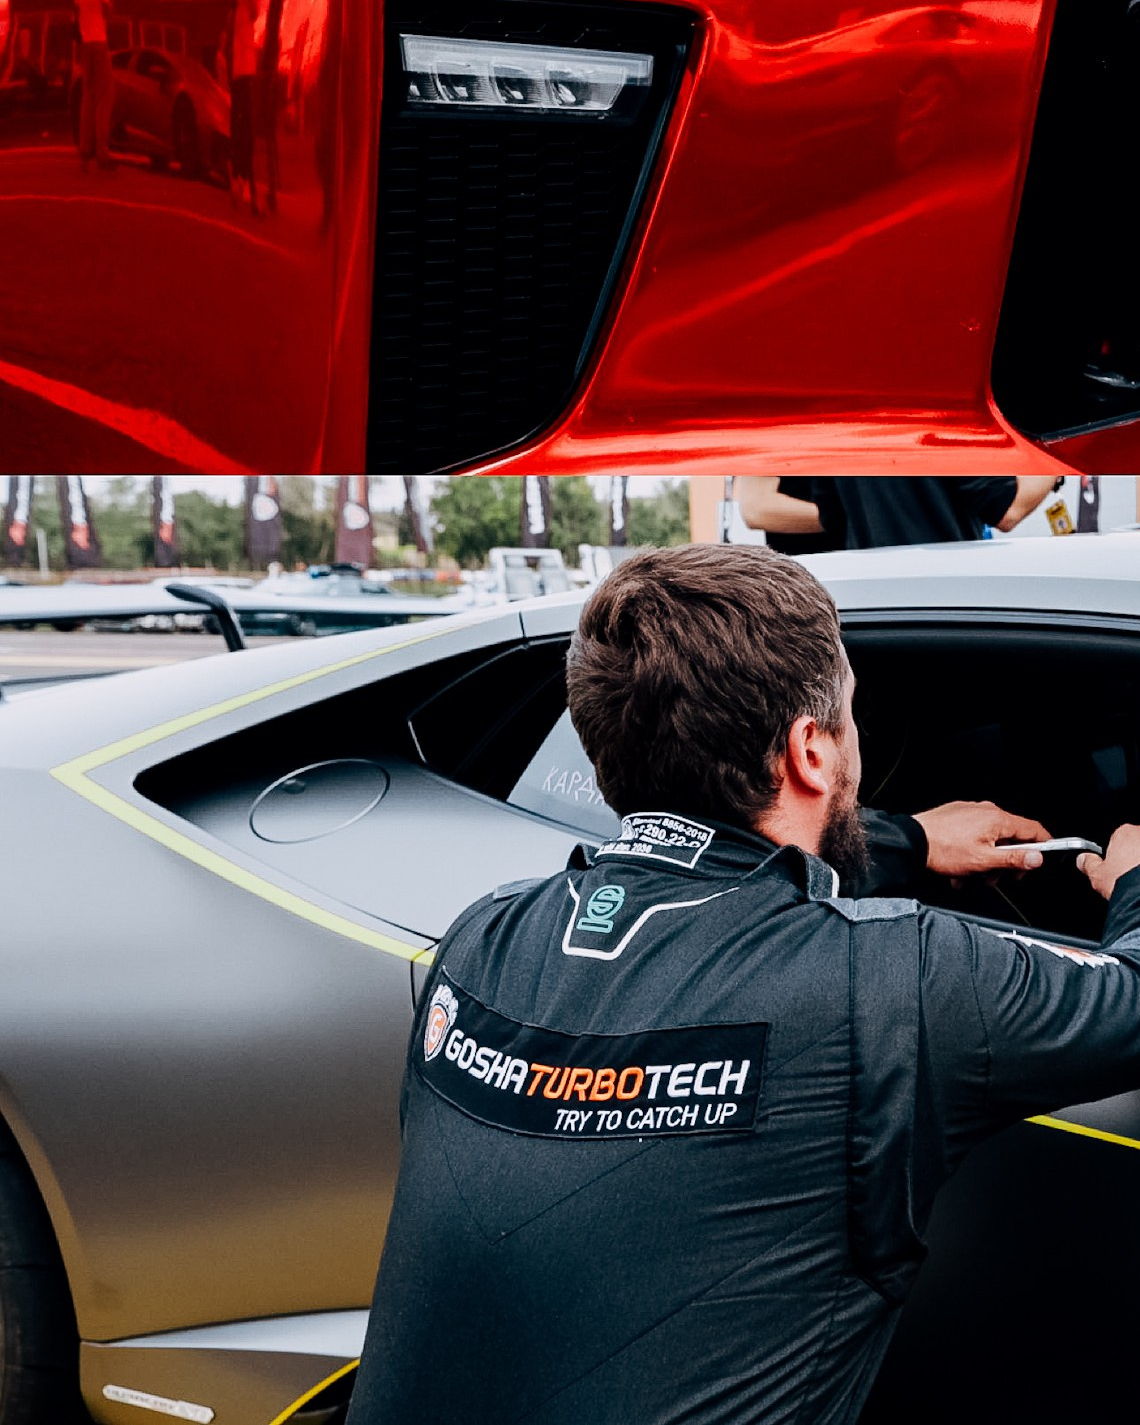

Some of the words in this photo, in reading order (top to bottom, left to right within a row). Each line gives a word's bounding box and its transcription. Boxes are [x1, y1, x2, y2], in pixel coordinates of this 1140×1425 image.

[445, 1029, 750, 1102] GOSHATURBOTECH
[554, 1109, 592, 1132] TRY
[596, 1109, 622, 1132] TO
[626, 1104, 700, 1129] CATCH
[704, 1102, 737, 1125] UP
